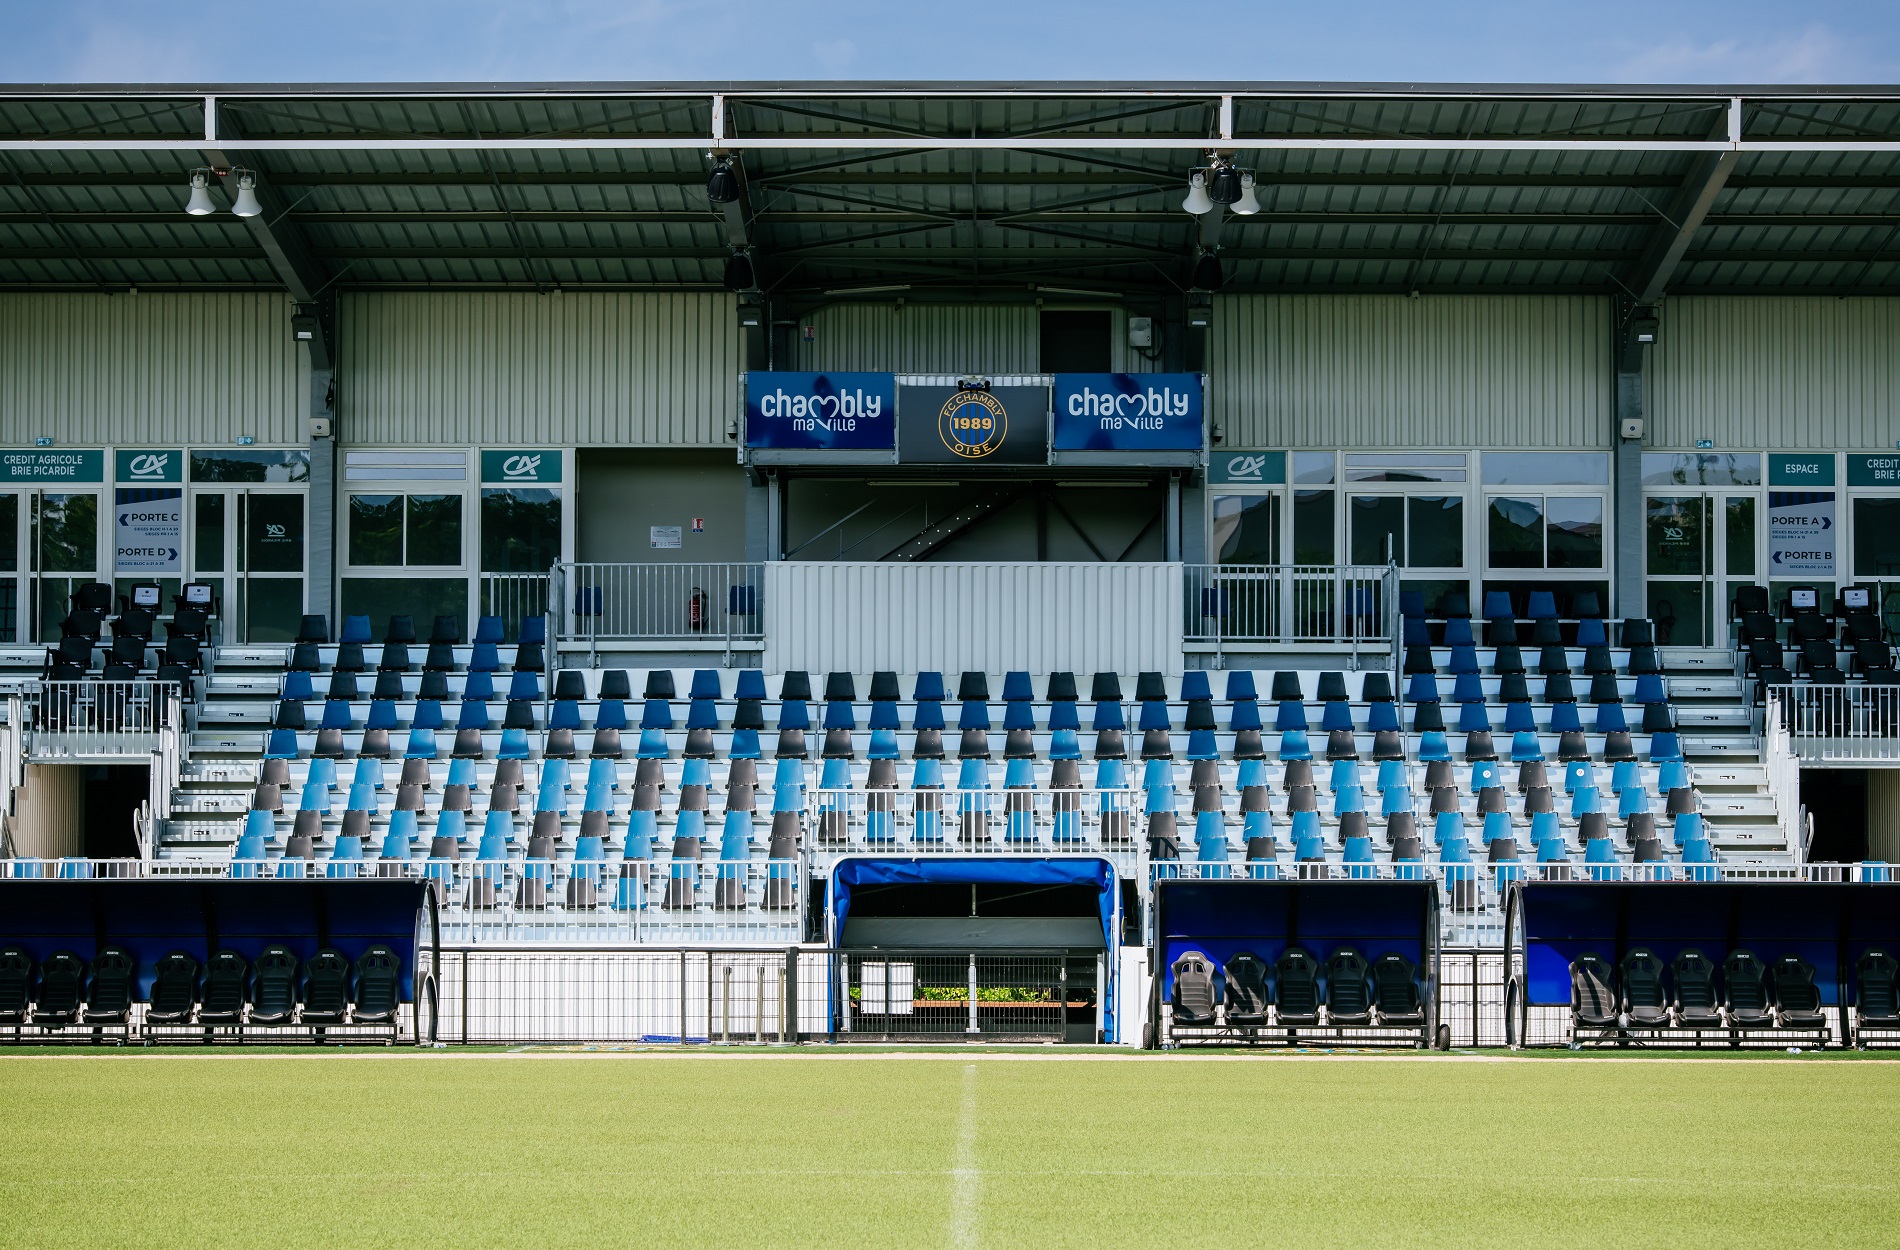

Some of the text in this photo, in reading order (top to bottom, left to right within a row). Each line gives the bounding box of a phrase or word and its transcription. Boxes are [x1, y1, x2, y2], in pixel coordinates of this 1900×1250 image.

[761, 388, 881, 418] chambly
[943, 393, 1003, 417] FC CHAMBLY
[1068, 386, 1189, 416] chambly
[793, 418, 815, 431] ma
[953, 417, 992, 430] 1989
[1100, 416, 1122, 430] ma
[954, 442, 992, 455] OISE
[3, 454, 83, 465] CREDIT AGRICOLE
[1867, 458, 1900, 469] CREDIT
[11, 465, 75, 476] BRIE PICARDIE
[1785, 463, 1819, 474] ESPACE
[1874, 469, 1895, 480] BRIE
[131, 513, 179, 522] PORTE C
[1771, 517, 1820, 525] PORTE A
[117, 548, 166, 556] PORTE D
[1784, 551, 1833, 560] PORTE B
